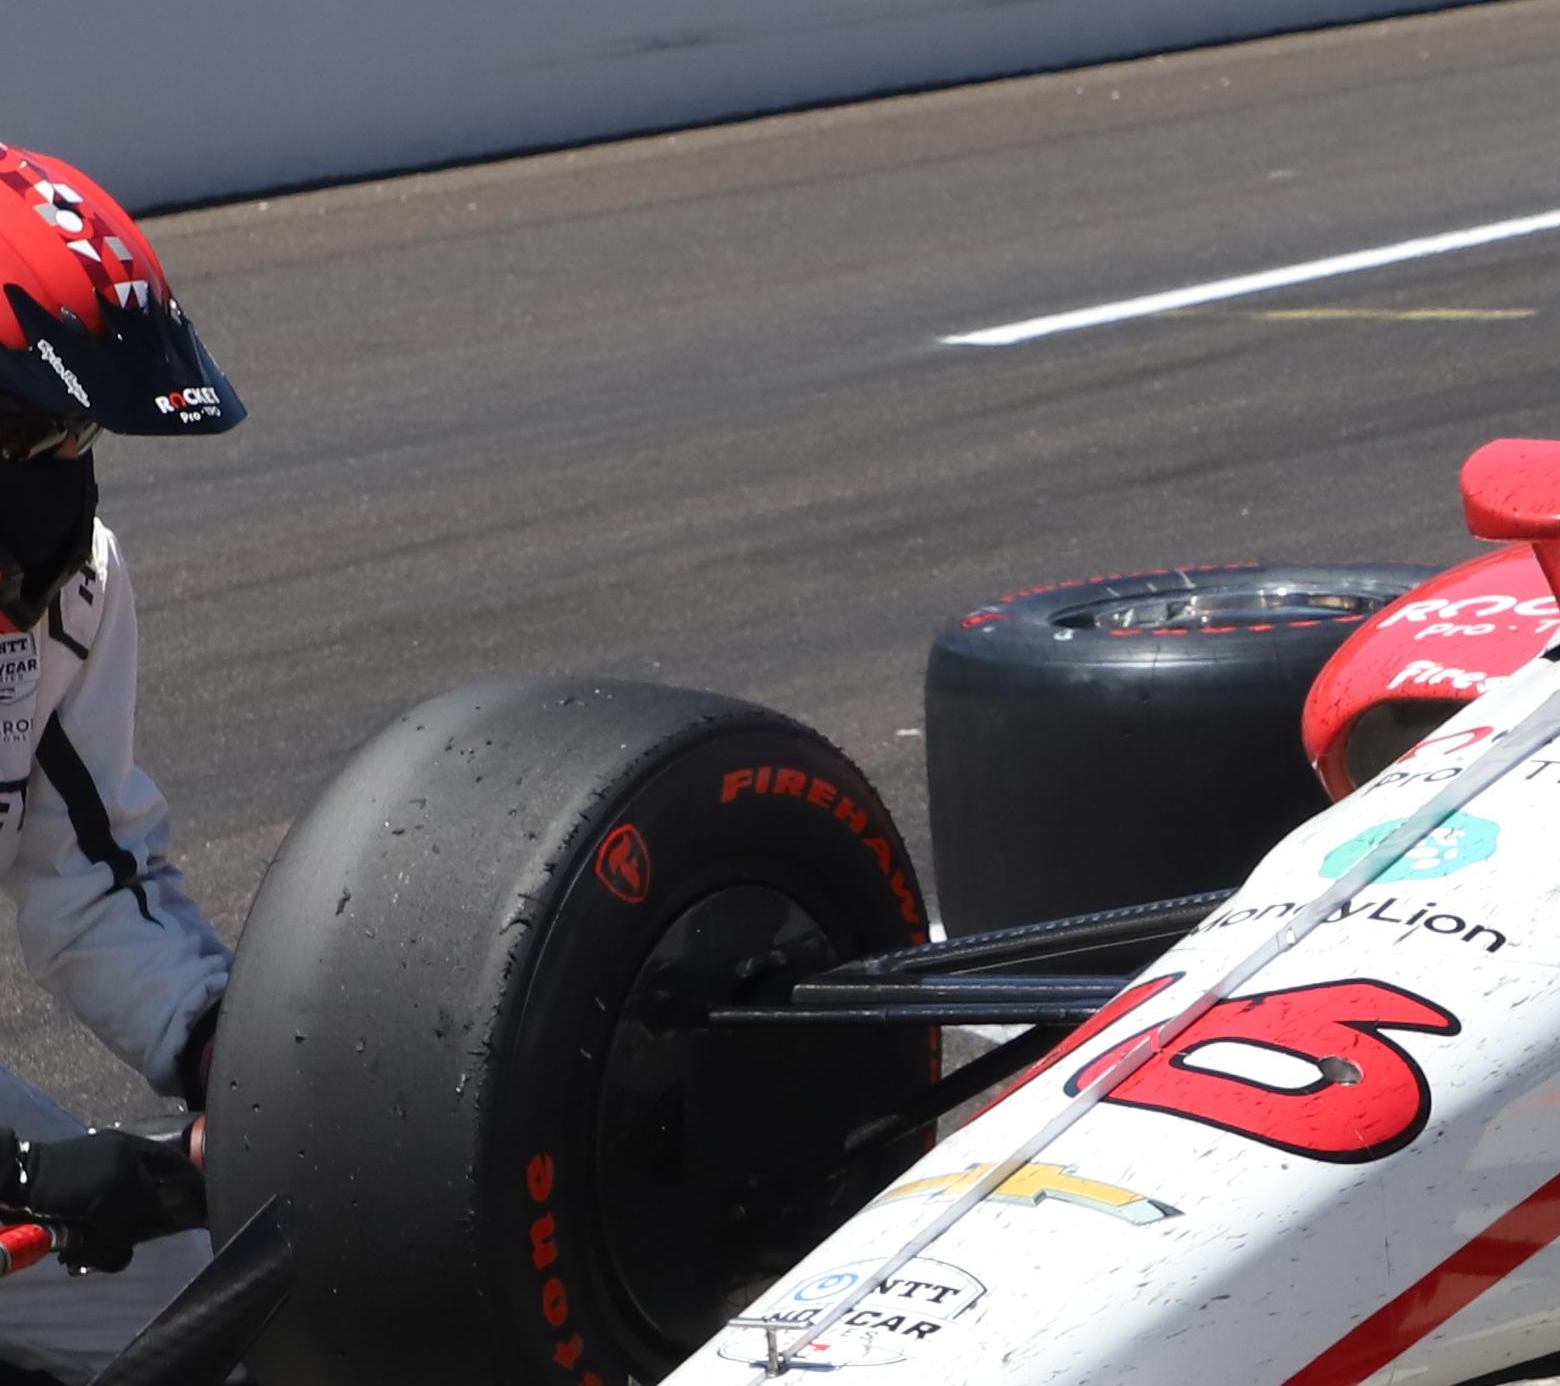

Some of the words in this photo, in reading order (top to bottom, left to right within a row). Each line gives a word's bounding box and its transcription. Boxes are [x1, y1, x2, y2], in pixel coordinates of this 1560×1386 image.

[155, 386, 221, 415] ROCKET
[720, 765, 927, 946] FIREHAW
[866, 1277, 961, 1305] NTT
